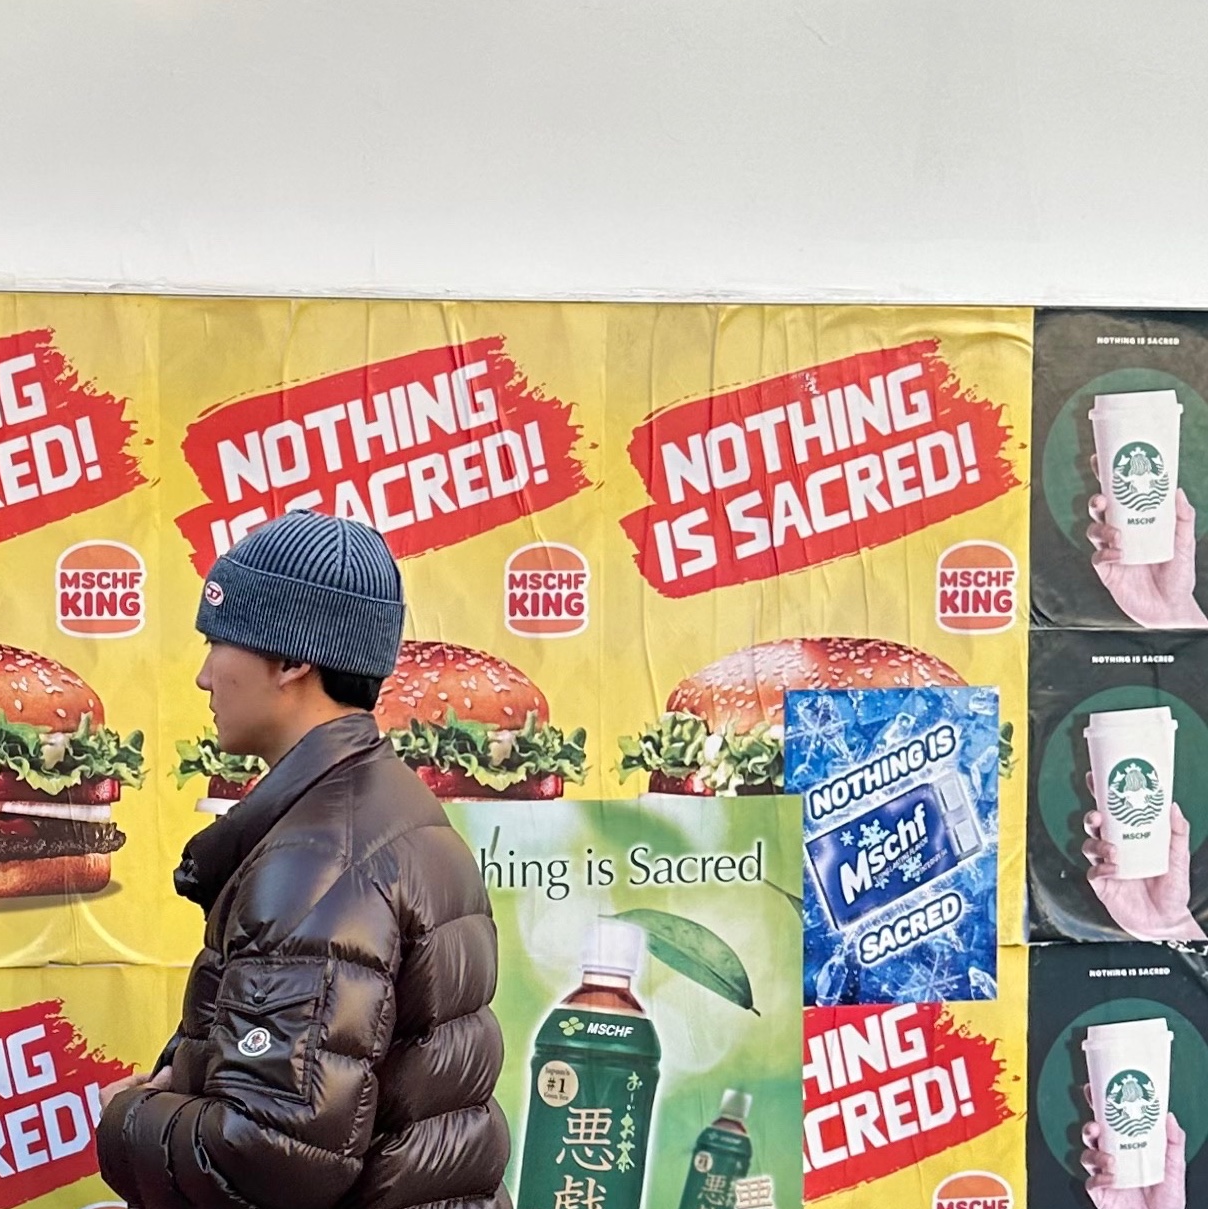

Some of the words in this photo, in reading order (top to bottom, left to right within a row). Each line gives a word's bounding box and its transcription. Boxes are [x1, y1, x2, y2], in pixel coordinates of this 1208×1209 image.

[1096, 337, 1135, 345] NOTHING
[1137, 337, 1145, 345] IS
[1147, 337, 1180, 345] SACRED
[217, 360, 498, 502] NOTHING
[661, 363, 932, 503] NOTHING
[284, 421, 549, 535] ACRED!
[654, 507, 717, 583] IS
[725, 422, 980, 560] SACRED!
[1127, 516, 1156, 525] MSCHF
[60, 571, 142, 590] MSCHF
[508, 572, 588, 591] MSCHF
[939, 569, 1014, 588] MSCHF
[61, 591, 141, 617] KING
[509, 591, 585, 617] KING
[940, 589, 1013, 615] KING
[1092, 656, 1130, 664] NOTHING
[1142, 655, 1175, 663] SACRED
[810, 740, 924, 819] NOTHING
[926, 726, 956, 761] IS
[1123, 831, 1152, 840] MSCHF
[839, 803, 927, 905] Mschf
[480, 848, 570, 900] hing
[587, 849, 614, 886] is
[629, 842, 763, 886] Sacred
[860, 893, 961, 965] SACRED
[1089, 969, 1127, 977] NOTHING
[1129, 968, 1137, 976] IS
[1138, 967, 1171, 976] SACRED
[587, 1023, 634, 1038] MSCHF
[803, 1002, 928, 1099] HING
[547, 1077, 566, 1093] #1
[803, 1056, 975, 1174] CRED!
[1120, 1142, 1148, 1150] MSCHF
